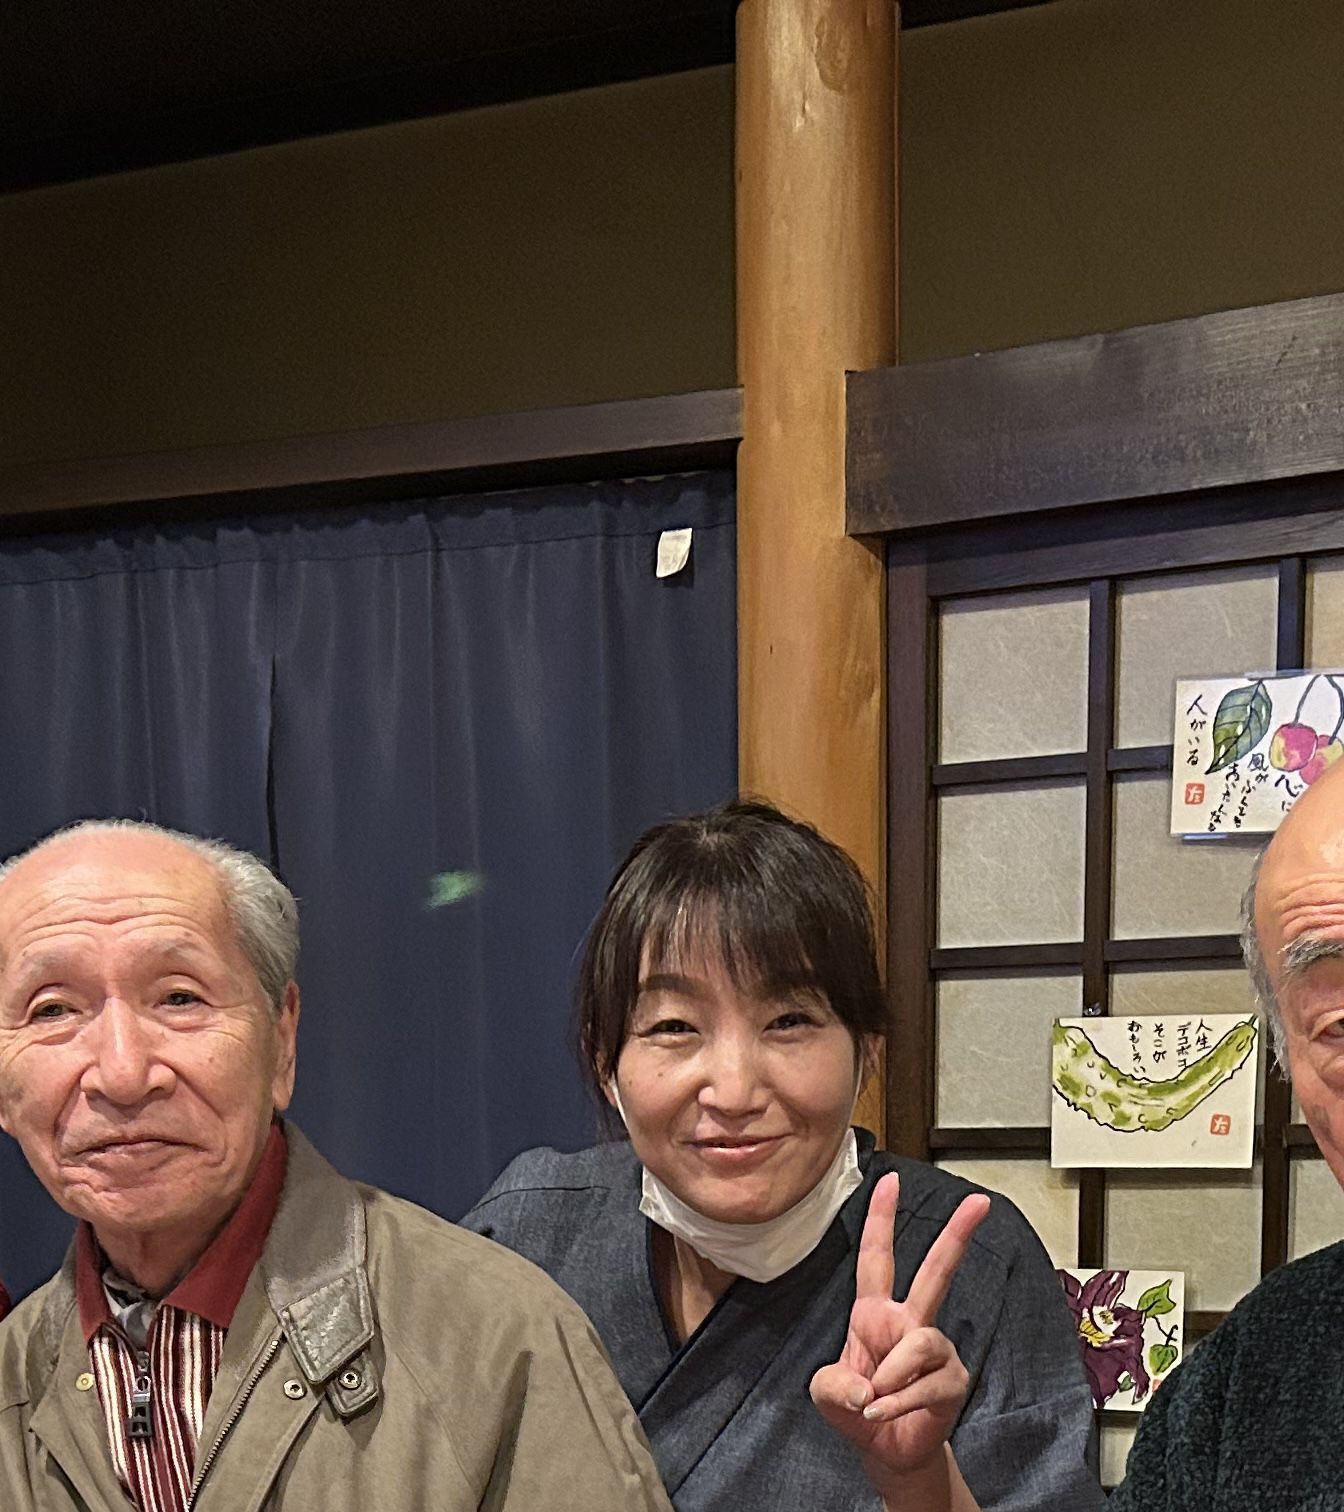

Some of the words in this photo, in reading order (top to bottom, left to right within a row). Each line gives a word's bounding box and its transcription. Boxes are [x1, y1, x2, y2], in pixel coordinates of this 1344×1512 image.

[1186, 694, 1207, 766] 人がいる
[1152, 1023, 1166, 1063] そこが
[1196, 1019, 1213, 1051] 人生
